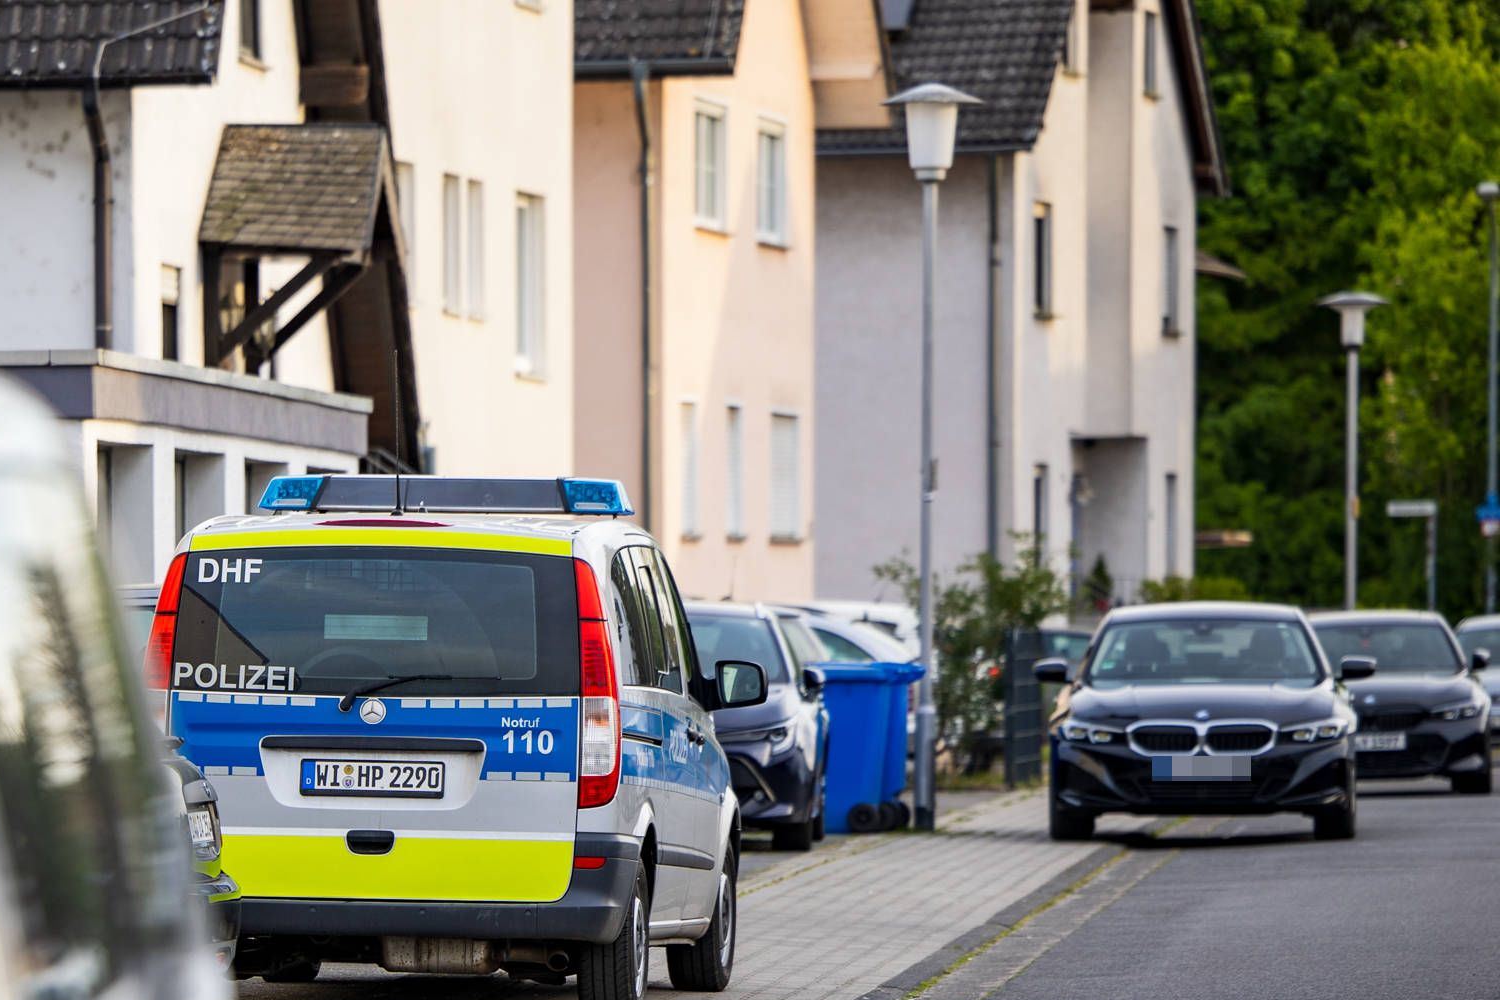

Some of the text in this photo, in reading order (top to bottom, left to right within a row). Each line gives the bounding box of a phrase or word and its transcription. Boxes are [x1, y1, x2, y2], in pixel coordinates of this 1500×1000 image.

[198, 558, 263, 583] DHF
[174, 662, 295, 691] POLIZEI
[501, 716, 541, 728] Notruf
[502, 729, 554, 755] 110
[305, 764, 440, 789] D WI HP 2290
